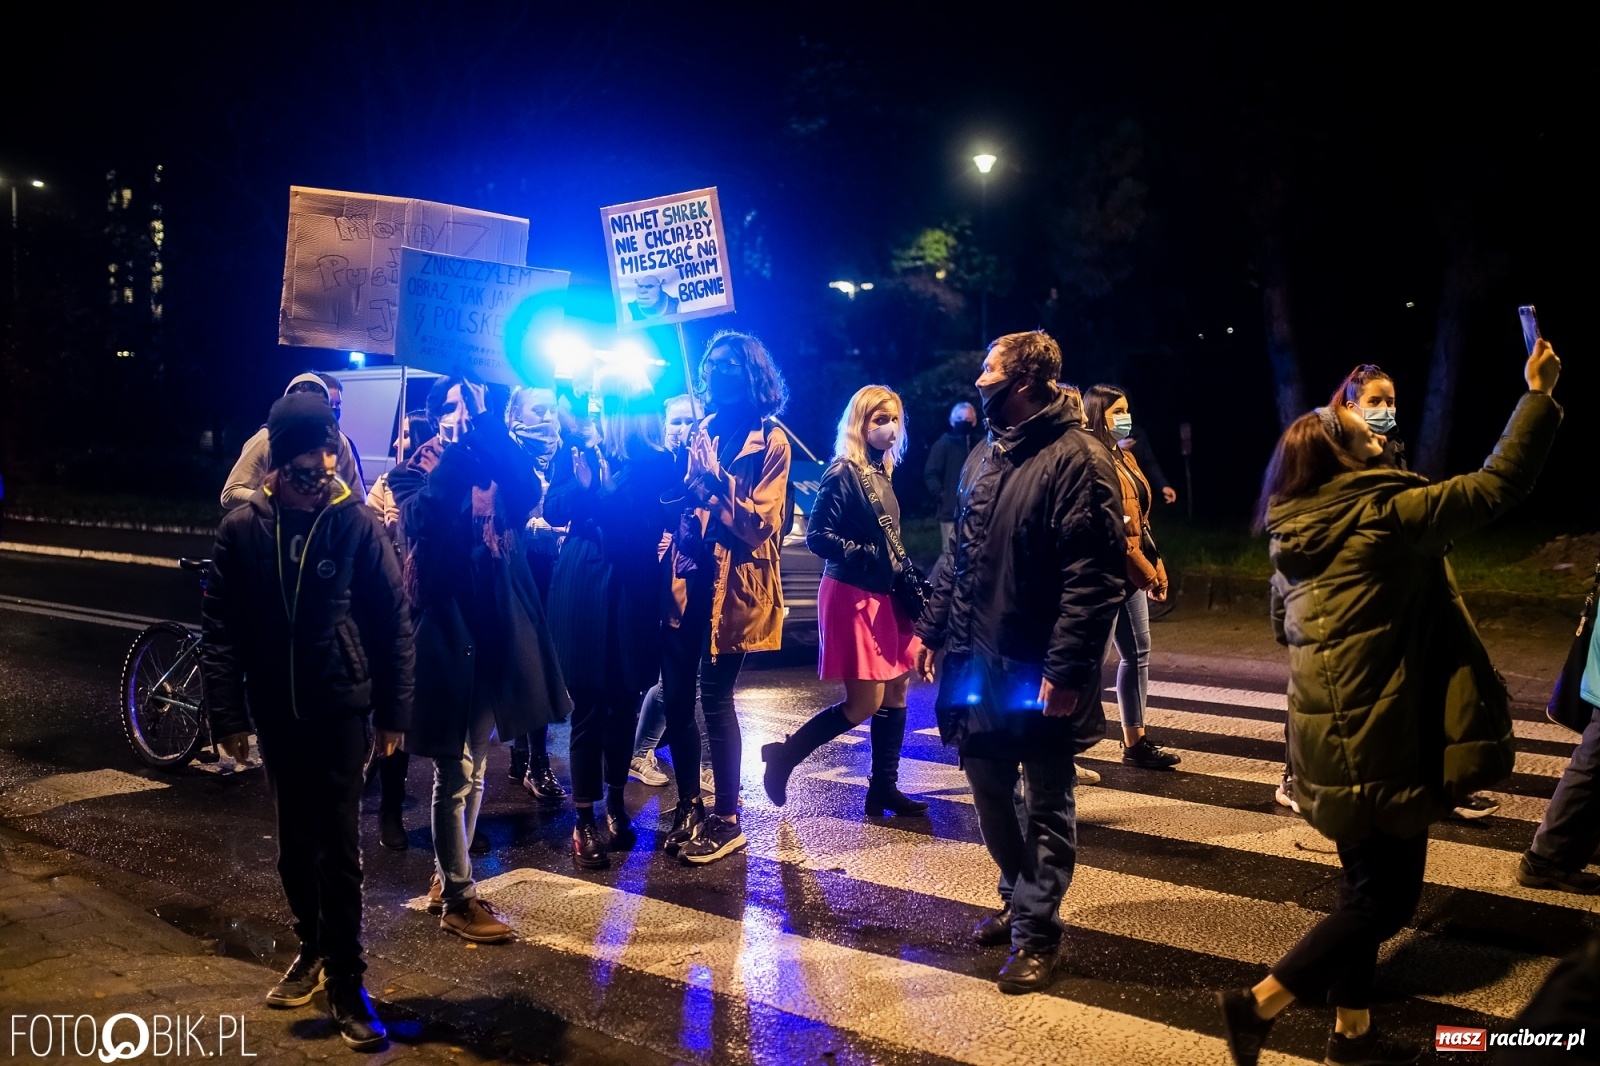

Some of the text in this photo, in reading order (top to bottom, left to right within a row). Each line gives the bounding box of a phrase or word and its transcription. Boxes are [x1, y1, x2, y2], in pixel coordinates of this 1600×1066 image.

[610, 200, 709, 234] NAWET SHREK
[614, 219, 713, 256] NIE CHCIAŁBY
[420, 253, 532, 289] ZNISZCZYŁEM
[620, 239, 718, 275] MIESZKAĆ NA
[675, 257, 719, 281] TAKIM
[407, 277, 454, 305] OBRAZ,
[459, 285, 486, 306] TAK
[488, 290, 516, 310] JAK
[678, 276, 725, 303] BAGNIE
